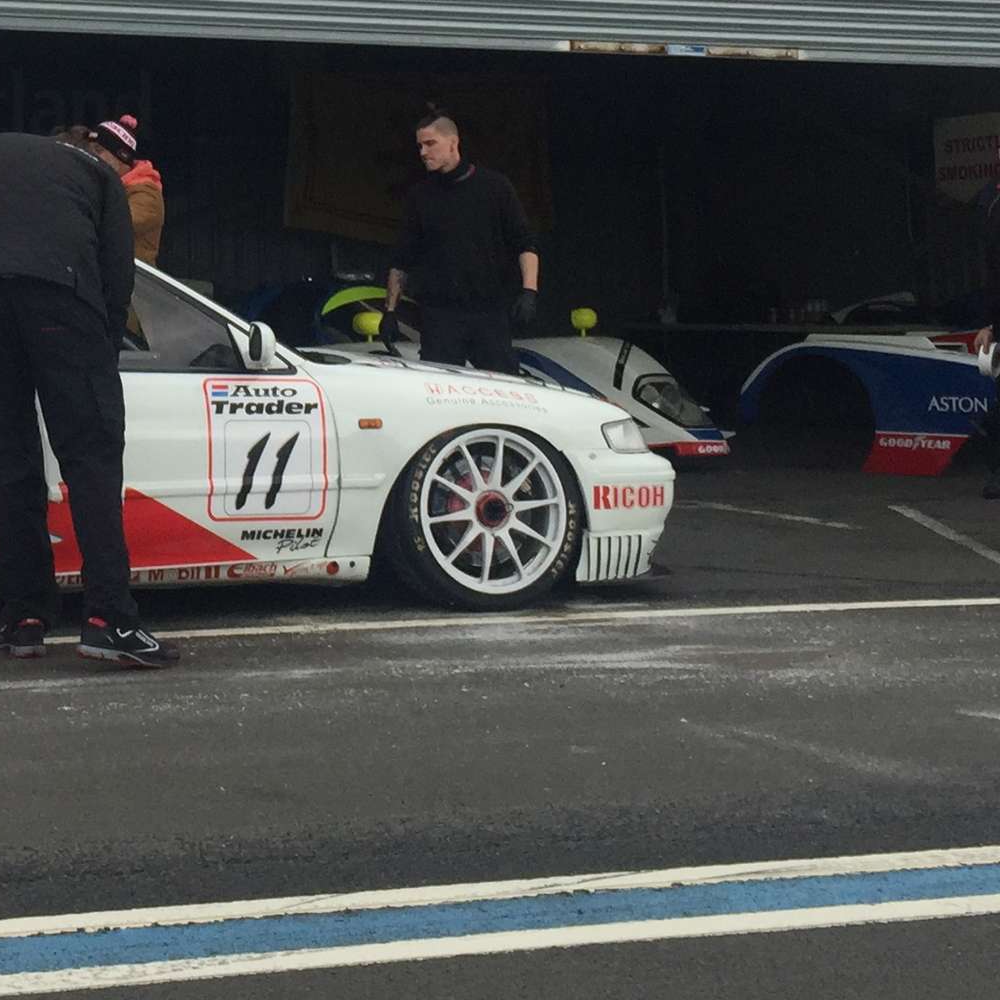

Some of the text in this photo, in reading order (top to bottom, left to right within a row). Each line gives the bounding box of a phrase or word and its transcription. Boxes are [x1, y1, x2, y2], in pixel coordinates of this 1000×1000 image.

[230, 385, 298, 397] Auto
[211, 399, 318, 415] Trader
[928, 395, 988, 413] ASTON
[879, 437, 951, 450] GOODYEAR
[235, 432, 300, 510] 11
[593, 485, 665, 510] RICOH
[240, 528, 323, 541] MICHELIN
